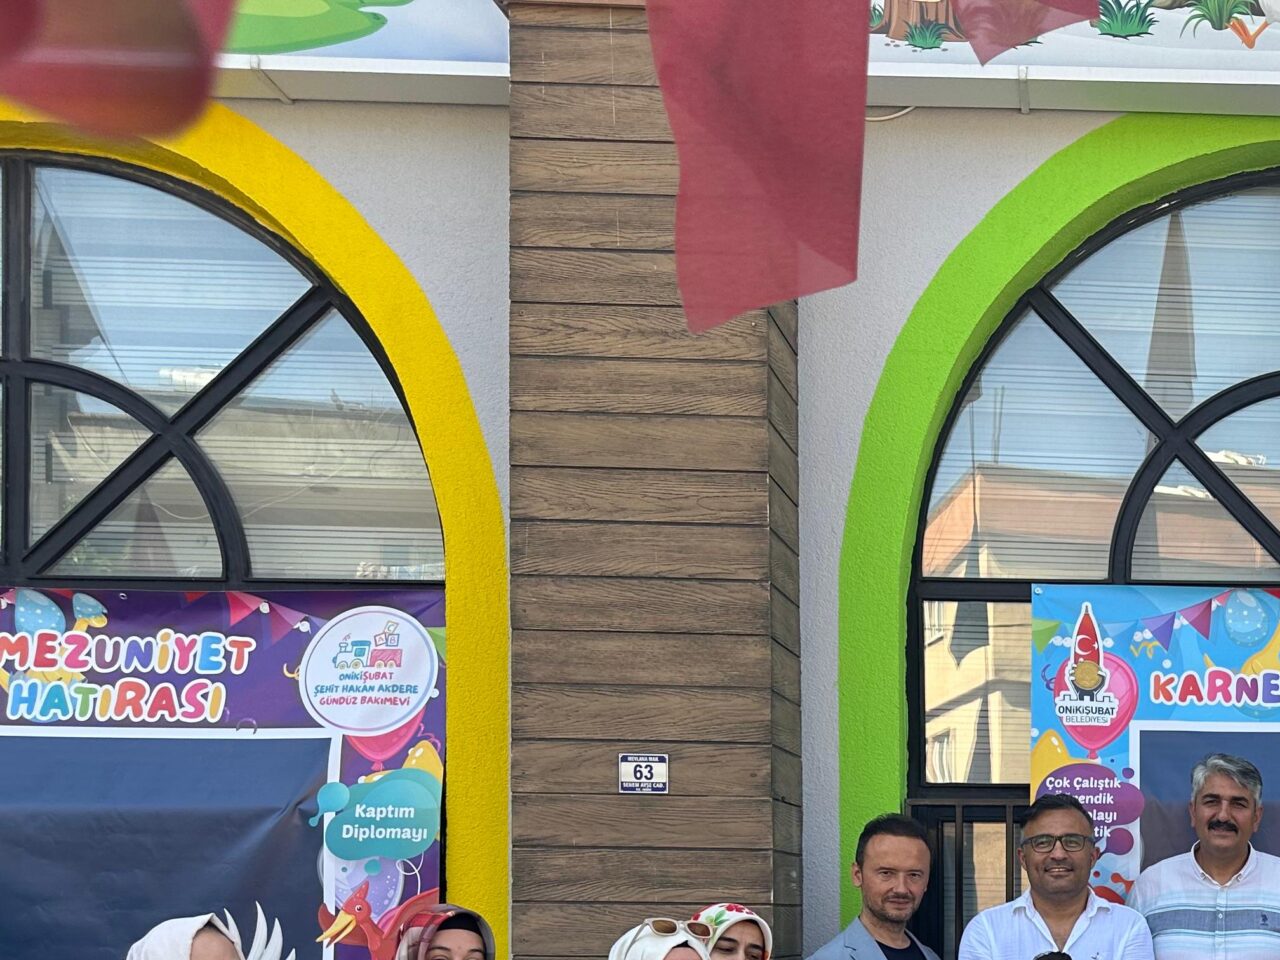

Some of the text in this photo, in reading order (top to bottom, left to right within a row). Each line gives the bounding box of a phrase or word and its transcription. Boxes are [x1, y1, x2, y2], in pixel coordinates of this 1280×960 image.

[0, 629, 255, 675] MEZUNİYET
[313, 684, 419, 698] ŞEHİT HAKAN AKDERE
[6, 677, 227, 723] HATIRASI
[319, 694, 358, 706] GÜNDÜZ
[1057, 705, 1116, 716] ONİKİŞUBAT
[1065, 715, 1109, 724] BELEDİYESİ
[633, 763, 654, 781] 63
[1046, 776, 1122, 791] Çok Çalıştık
[355, 804, 415, 821] Kaptım
[342, 824, 428, 842] Diplomayı
